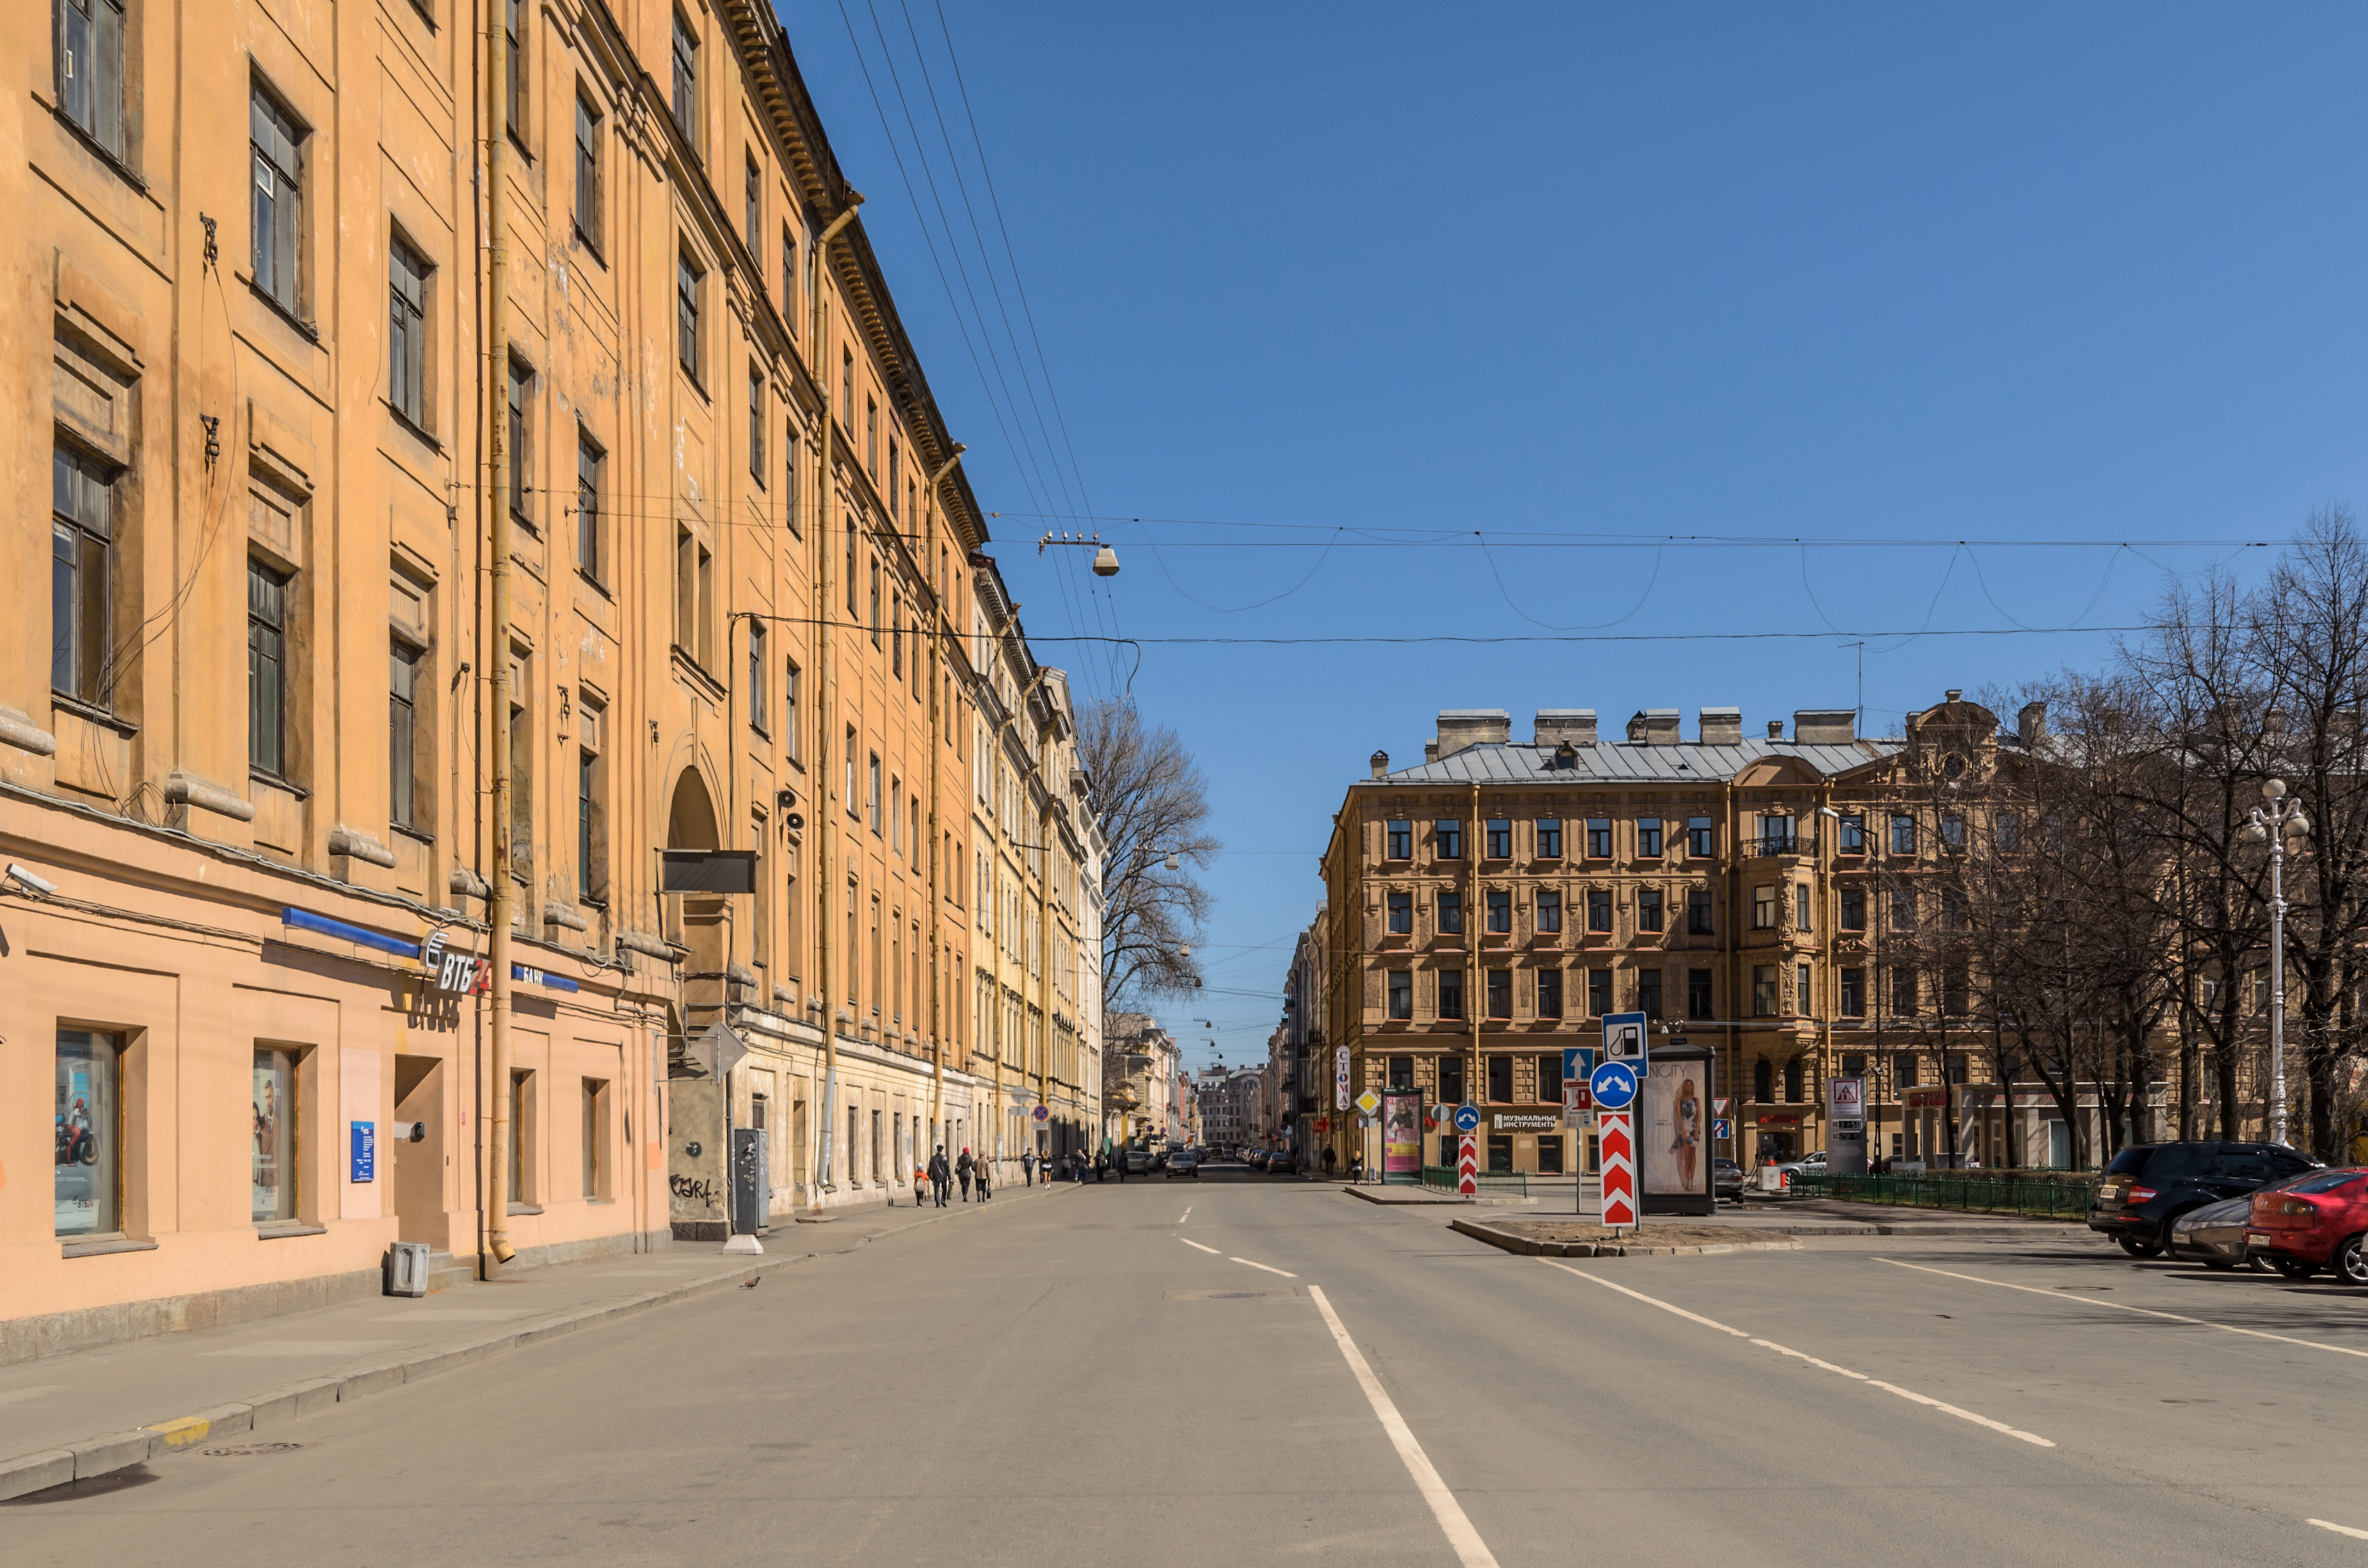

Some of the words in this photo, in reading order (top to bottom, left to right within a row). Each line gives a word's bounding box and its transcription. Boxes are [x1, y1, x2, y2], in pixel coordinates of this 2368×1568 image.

[440, 953, 492, 996] ВТБ24
[524, 967, 544, 987] БАНК
[1339, 1051, 1348, 1104] СТОМА
[1649, 1064, 1688, 1078] NCITY
[1760, 1115, 1798, 1123] KAWAI
